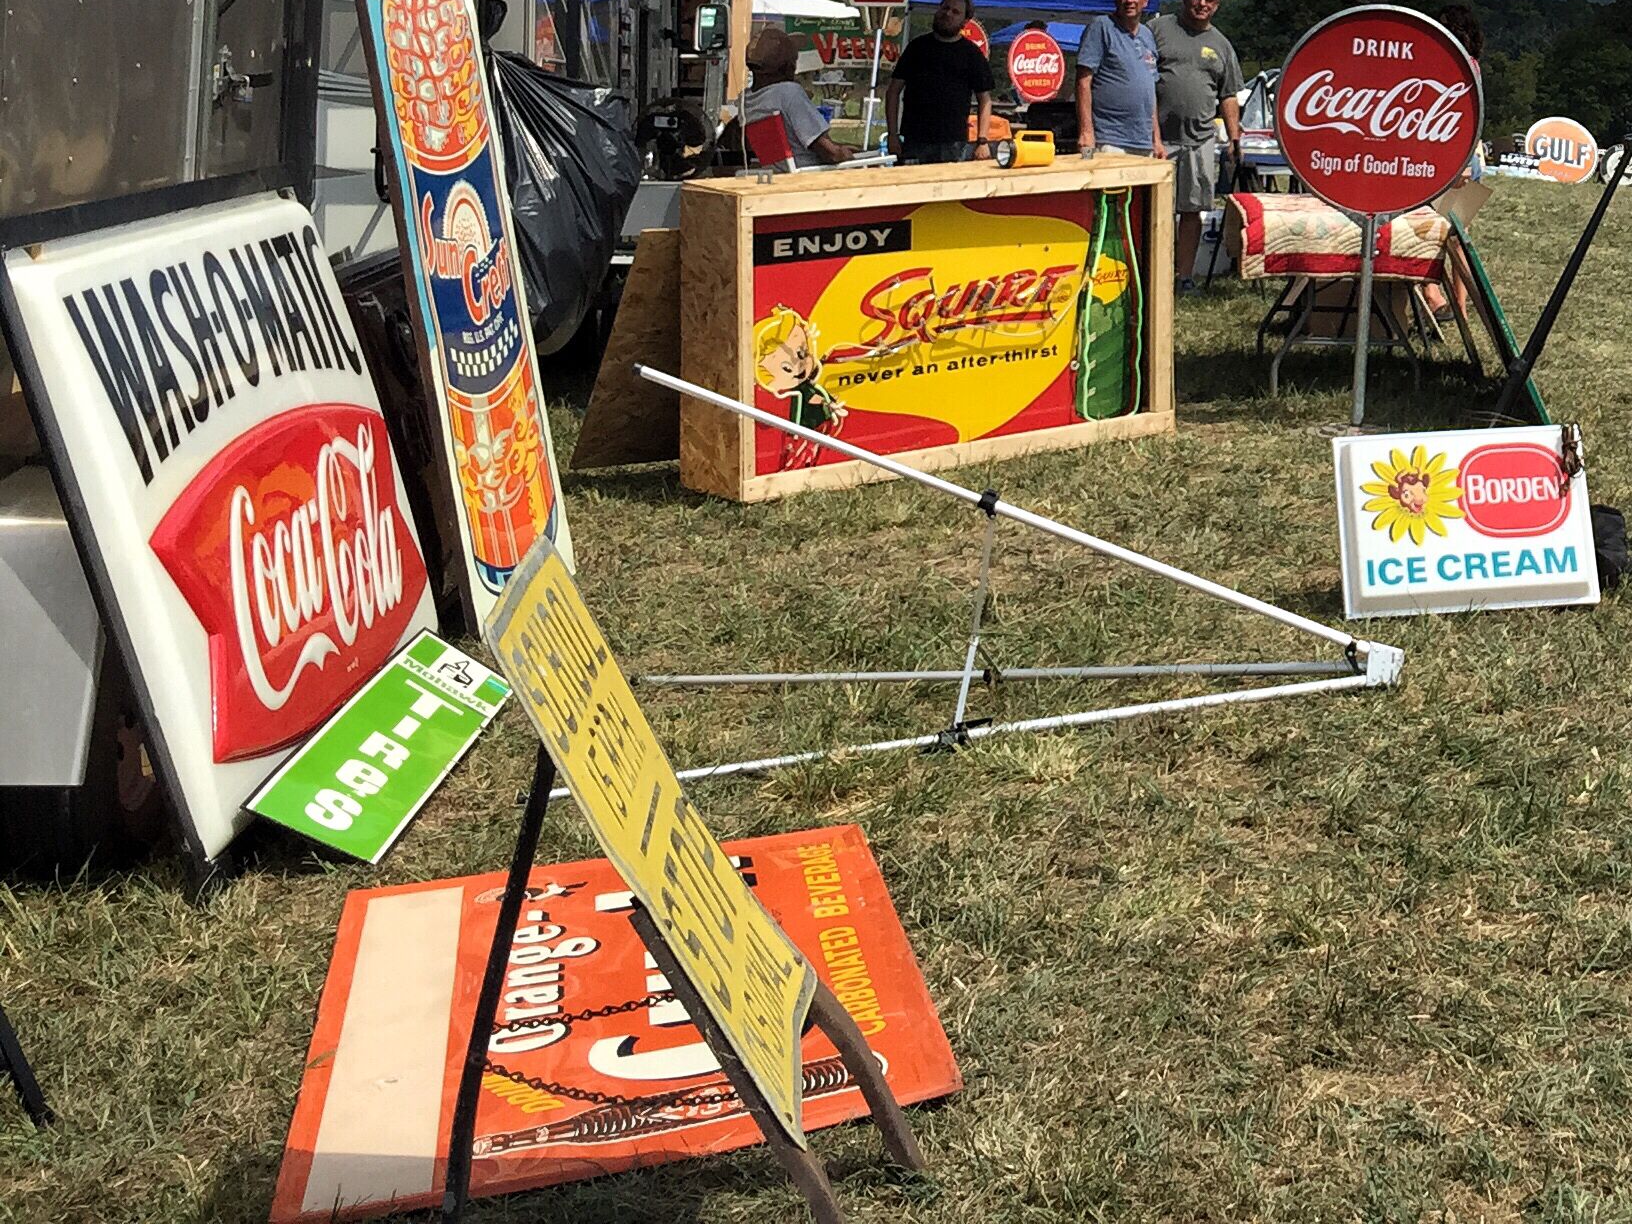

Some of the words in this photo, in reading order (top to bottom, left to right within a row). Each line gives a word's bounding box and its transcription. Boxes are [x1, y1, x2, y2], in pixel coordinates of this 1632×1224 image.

[811, 32, 899, 65] VEEDO
[1013, 54, 1060, 75] Coca-Cola
[1353, 37, 1414, 60] DRINK
[1284, 69, 1474, 143] Coca-Cola
[1310, 149, 1342, 175] Sign
[1344, 153, 1362, 173] of
[1362, 154, 1398, 175] Good
[1401, 157, 1436, 178] Taste
[1533, 133, 1593, 169] GULF
[422, 190, 462, 279] Sun
[462, 236, 511, 325] Crest
[773, 227, 893, 258] ENJOY
[62, 225, 362, 487] WASH-O-MATIC
[838, 367, 904, 387] never
[911, 362, 939, 376] an
[946, 344, 1059, 371] after-thirst
[1466, 474, 1560, 505] BORDEN
[229, 416, 403, 711] Coca-Cola
[1366, 556, 1428, 586] ICE
[1436, 545, 1579, 581] CREAM
[403, 657, 487, 712] Mohawk
[509, 576, 607, 755] SCHOOL
[796, 842, 850, 920] BEVERAGE
[660, 795, 738, 1014] STOP
[818, 925, 888, 1038] CARBONATED
[481, 1073, 567, 1114] DRIN
